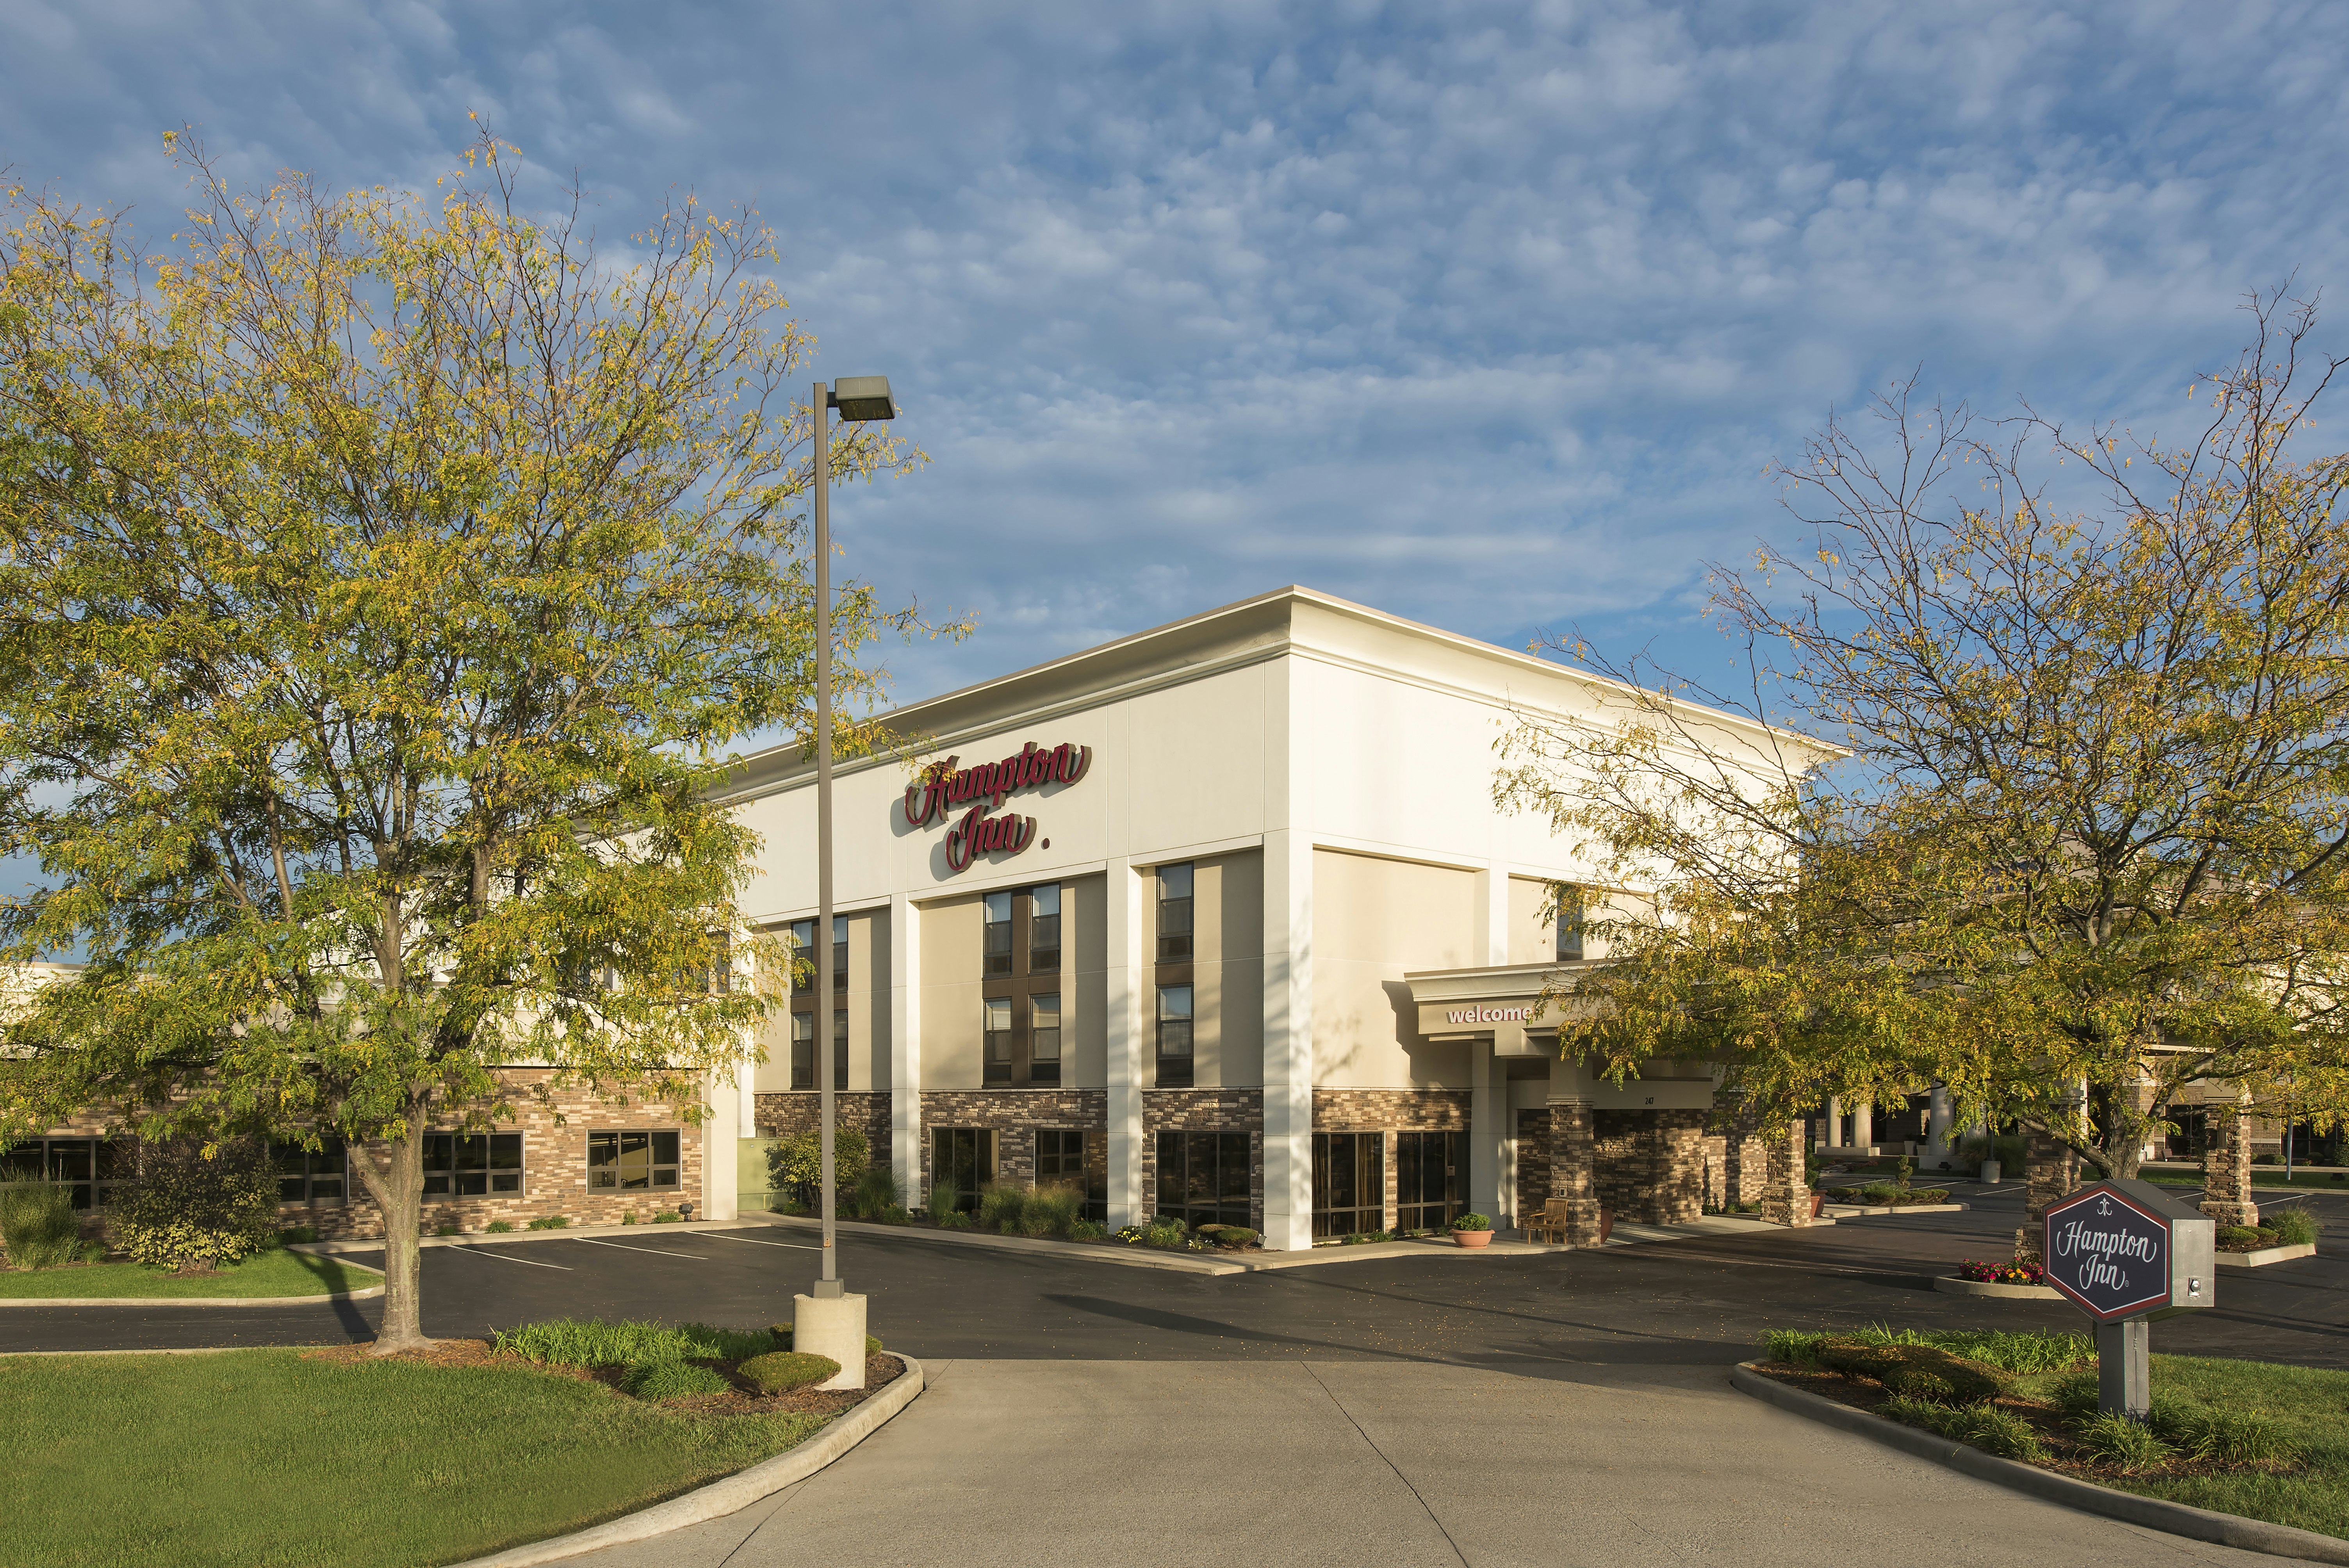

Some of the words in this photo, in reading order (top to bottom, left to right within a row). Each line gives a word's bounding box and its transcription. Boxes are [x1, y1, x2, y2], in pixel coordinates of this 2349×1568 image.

[905, 741, 1092, 825] Hampton
[946, 805, 1037, 871] Inn
[2057, 1221, 2157, 1263] Hampton
[2079, 1254, 2125, 1290] Inn
